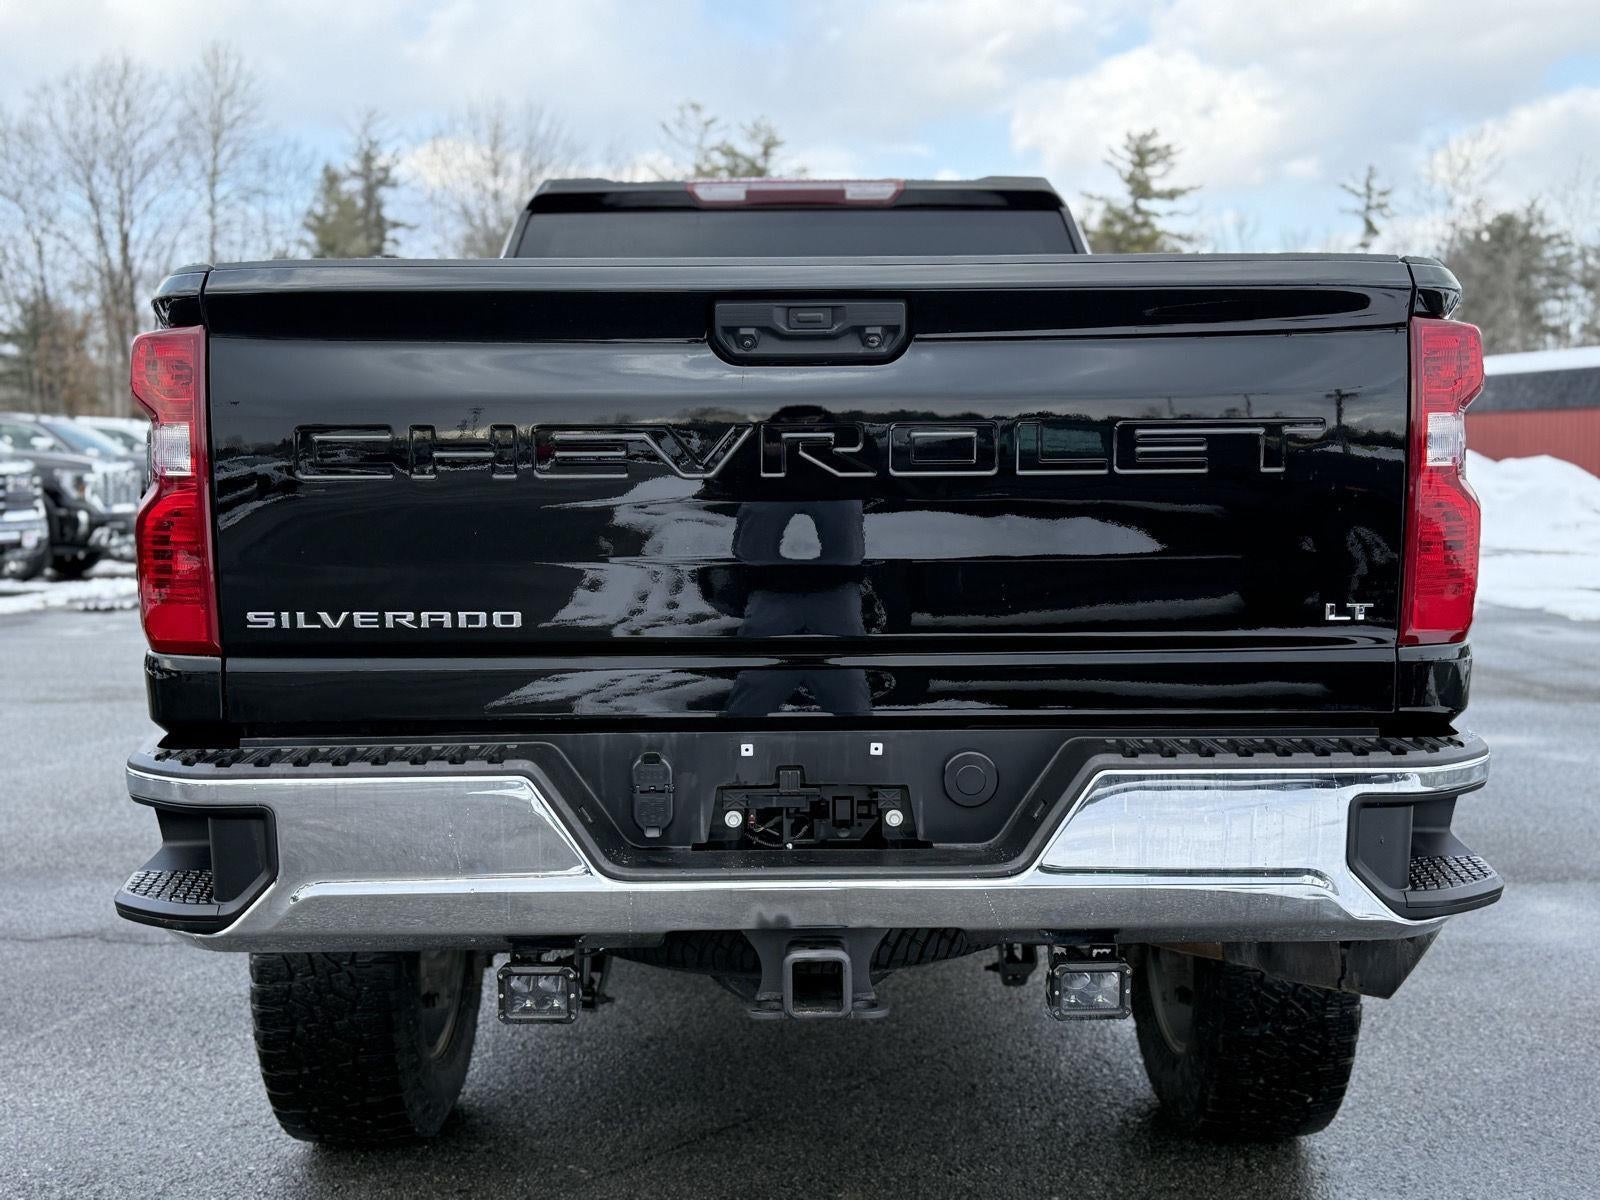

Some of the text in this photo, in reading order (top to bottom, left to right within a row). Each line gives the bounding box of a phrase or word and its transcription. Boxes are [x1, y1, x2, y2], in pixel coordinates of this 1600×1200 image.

[294, 417, 1326, 479] CHEVROLET
[246, 610, 523, 629] SILVERADO
[1325, 602, 1374, 621] LT
